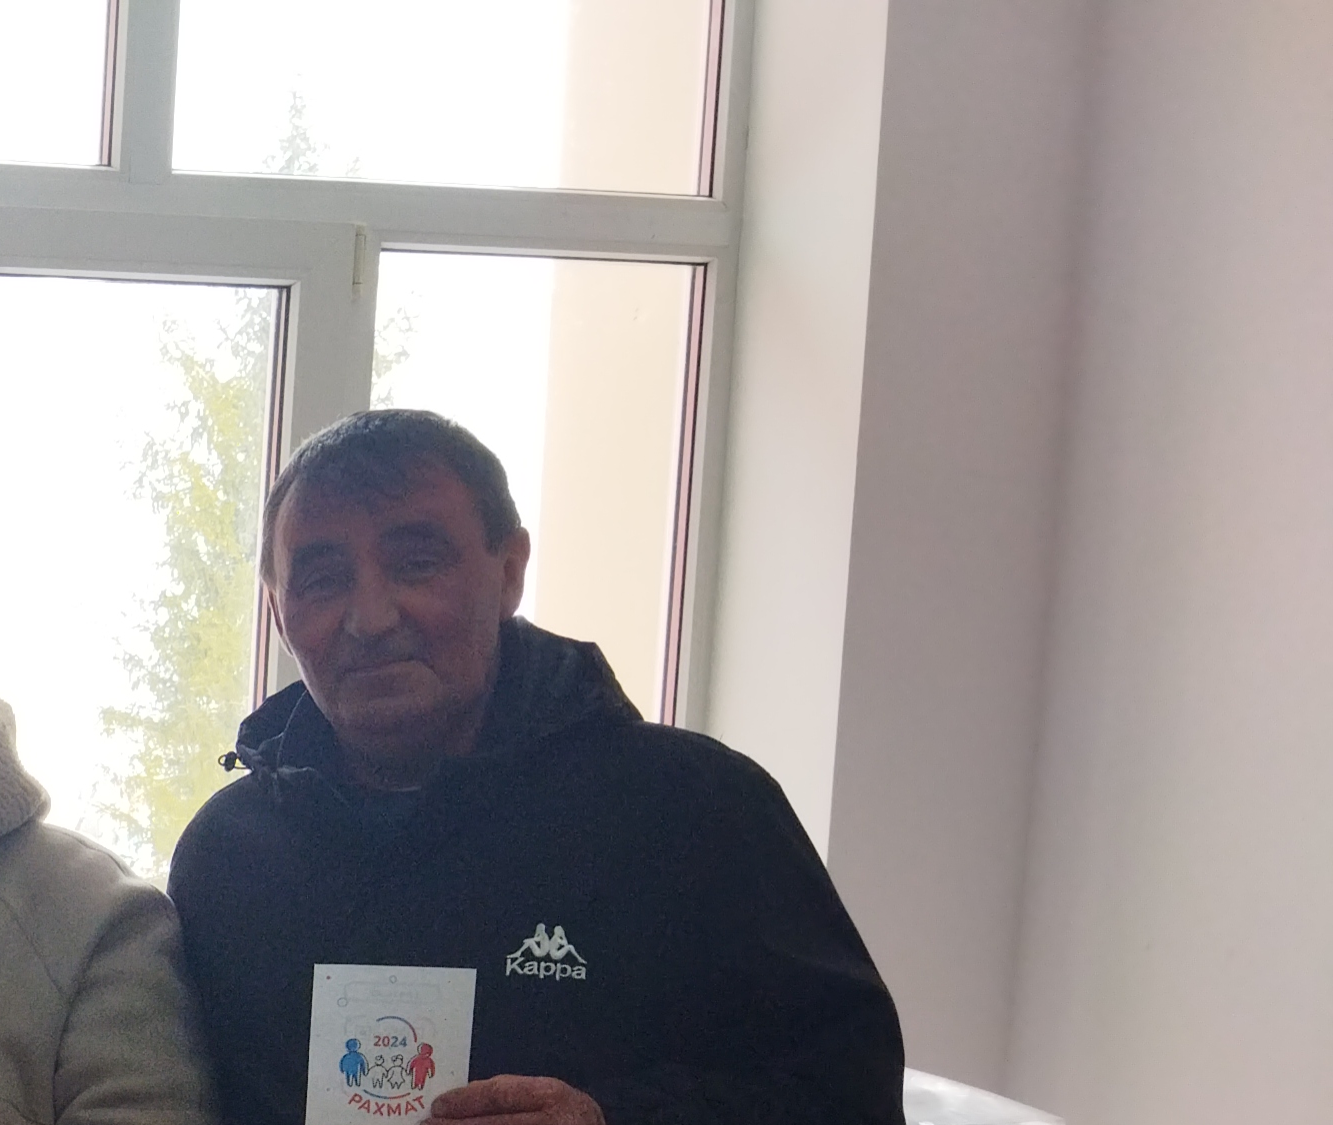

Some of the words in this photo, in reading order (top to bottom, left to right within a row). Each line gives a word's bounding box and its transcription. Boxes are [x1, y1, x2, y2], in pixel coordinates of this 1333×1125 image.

[505, 956, 587, 981] Kappa
[372, 1034, 408, 1049] 2024
[347, 1092, 427, 1118] РАХМАТ
